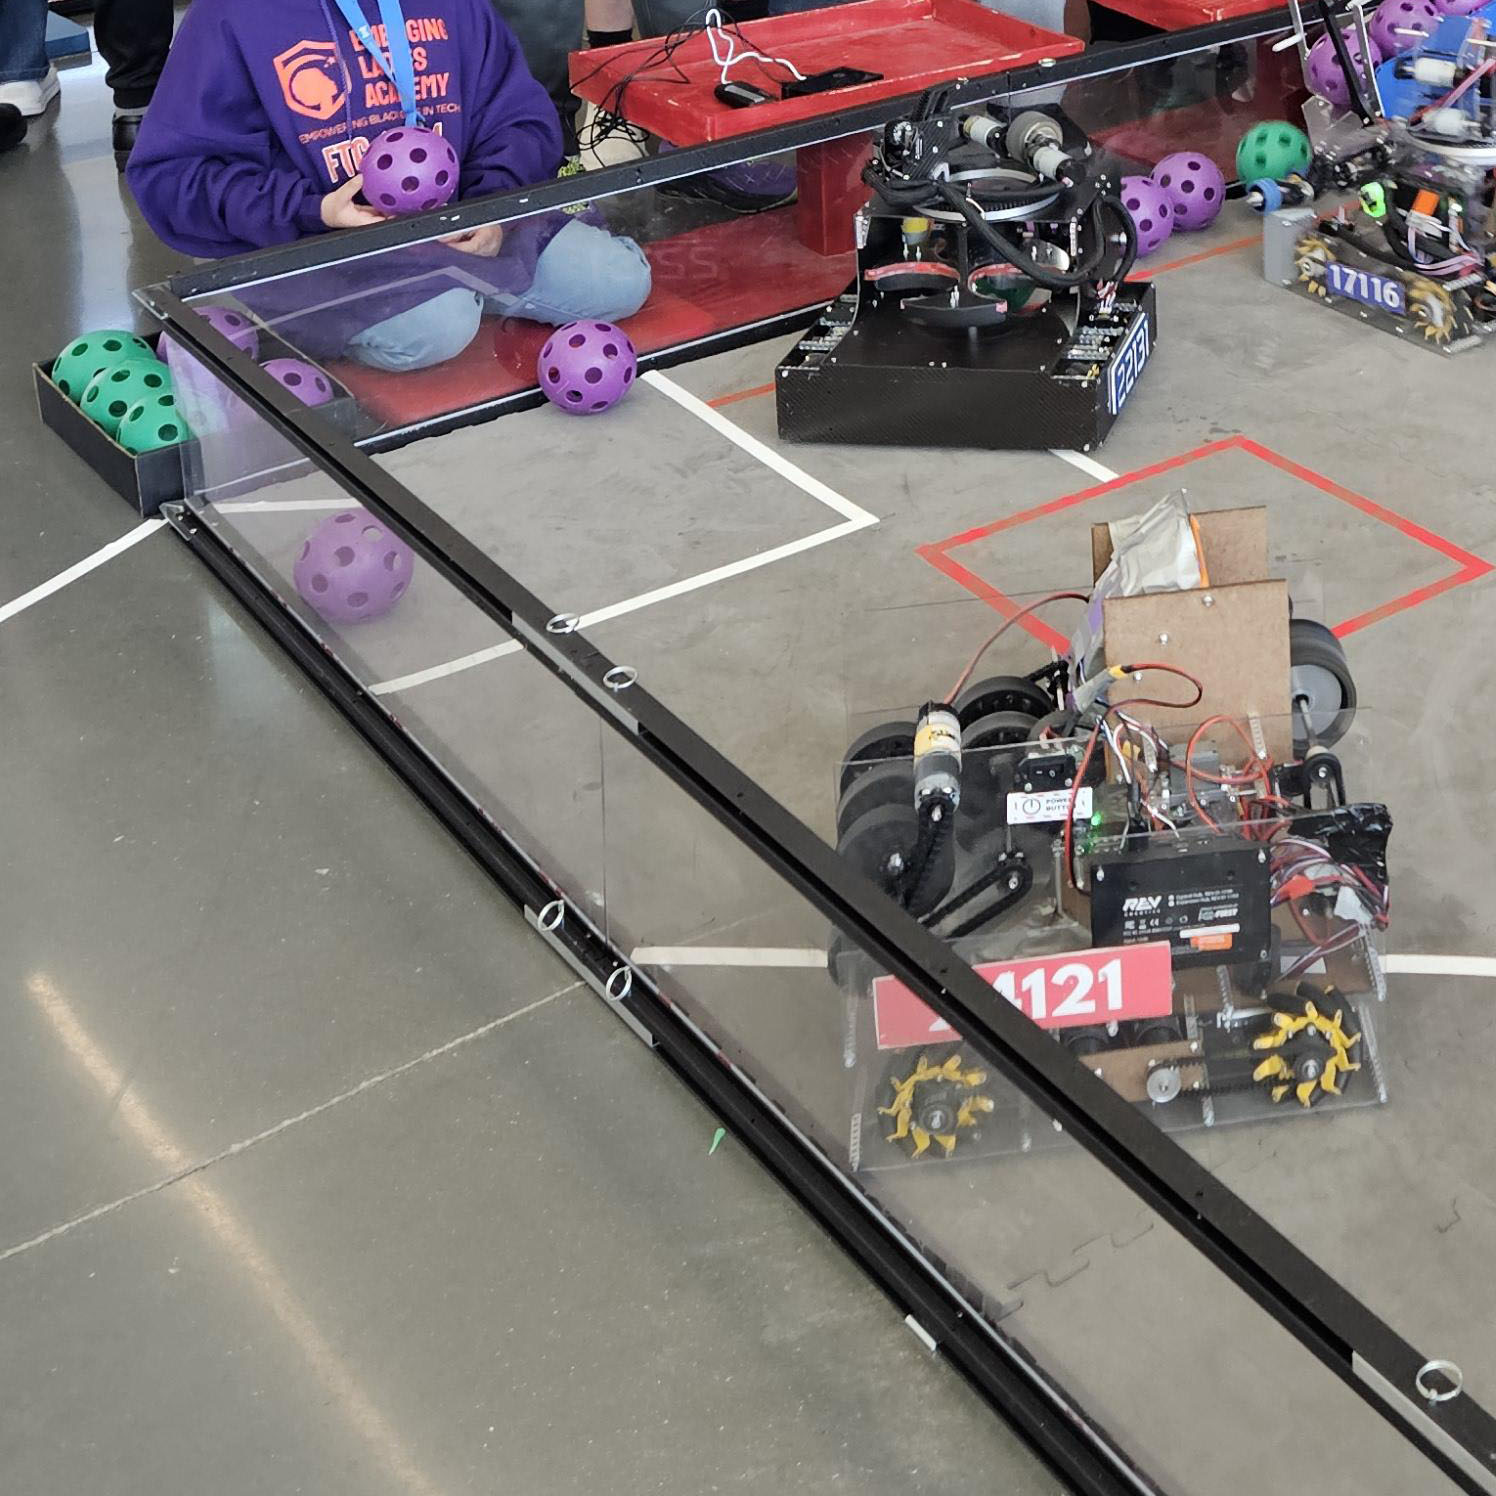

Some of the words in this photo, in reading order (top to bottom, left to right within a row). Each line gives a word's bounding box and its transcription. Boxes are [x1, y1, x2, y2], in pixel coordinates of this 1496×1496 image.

[1328, 264, 1400, 308] 17116
[1117, 319, 1150, 409] 22131
[929, 958, 1123, 1032] 4121
